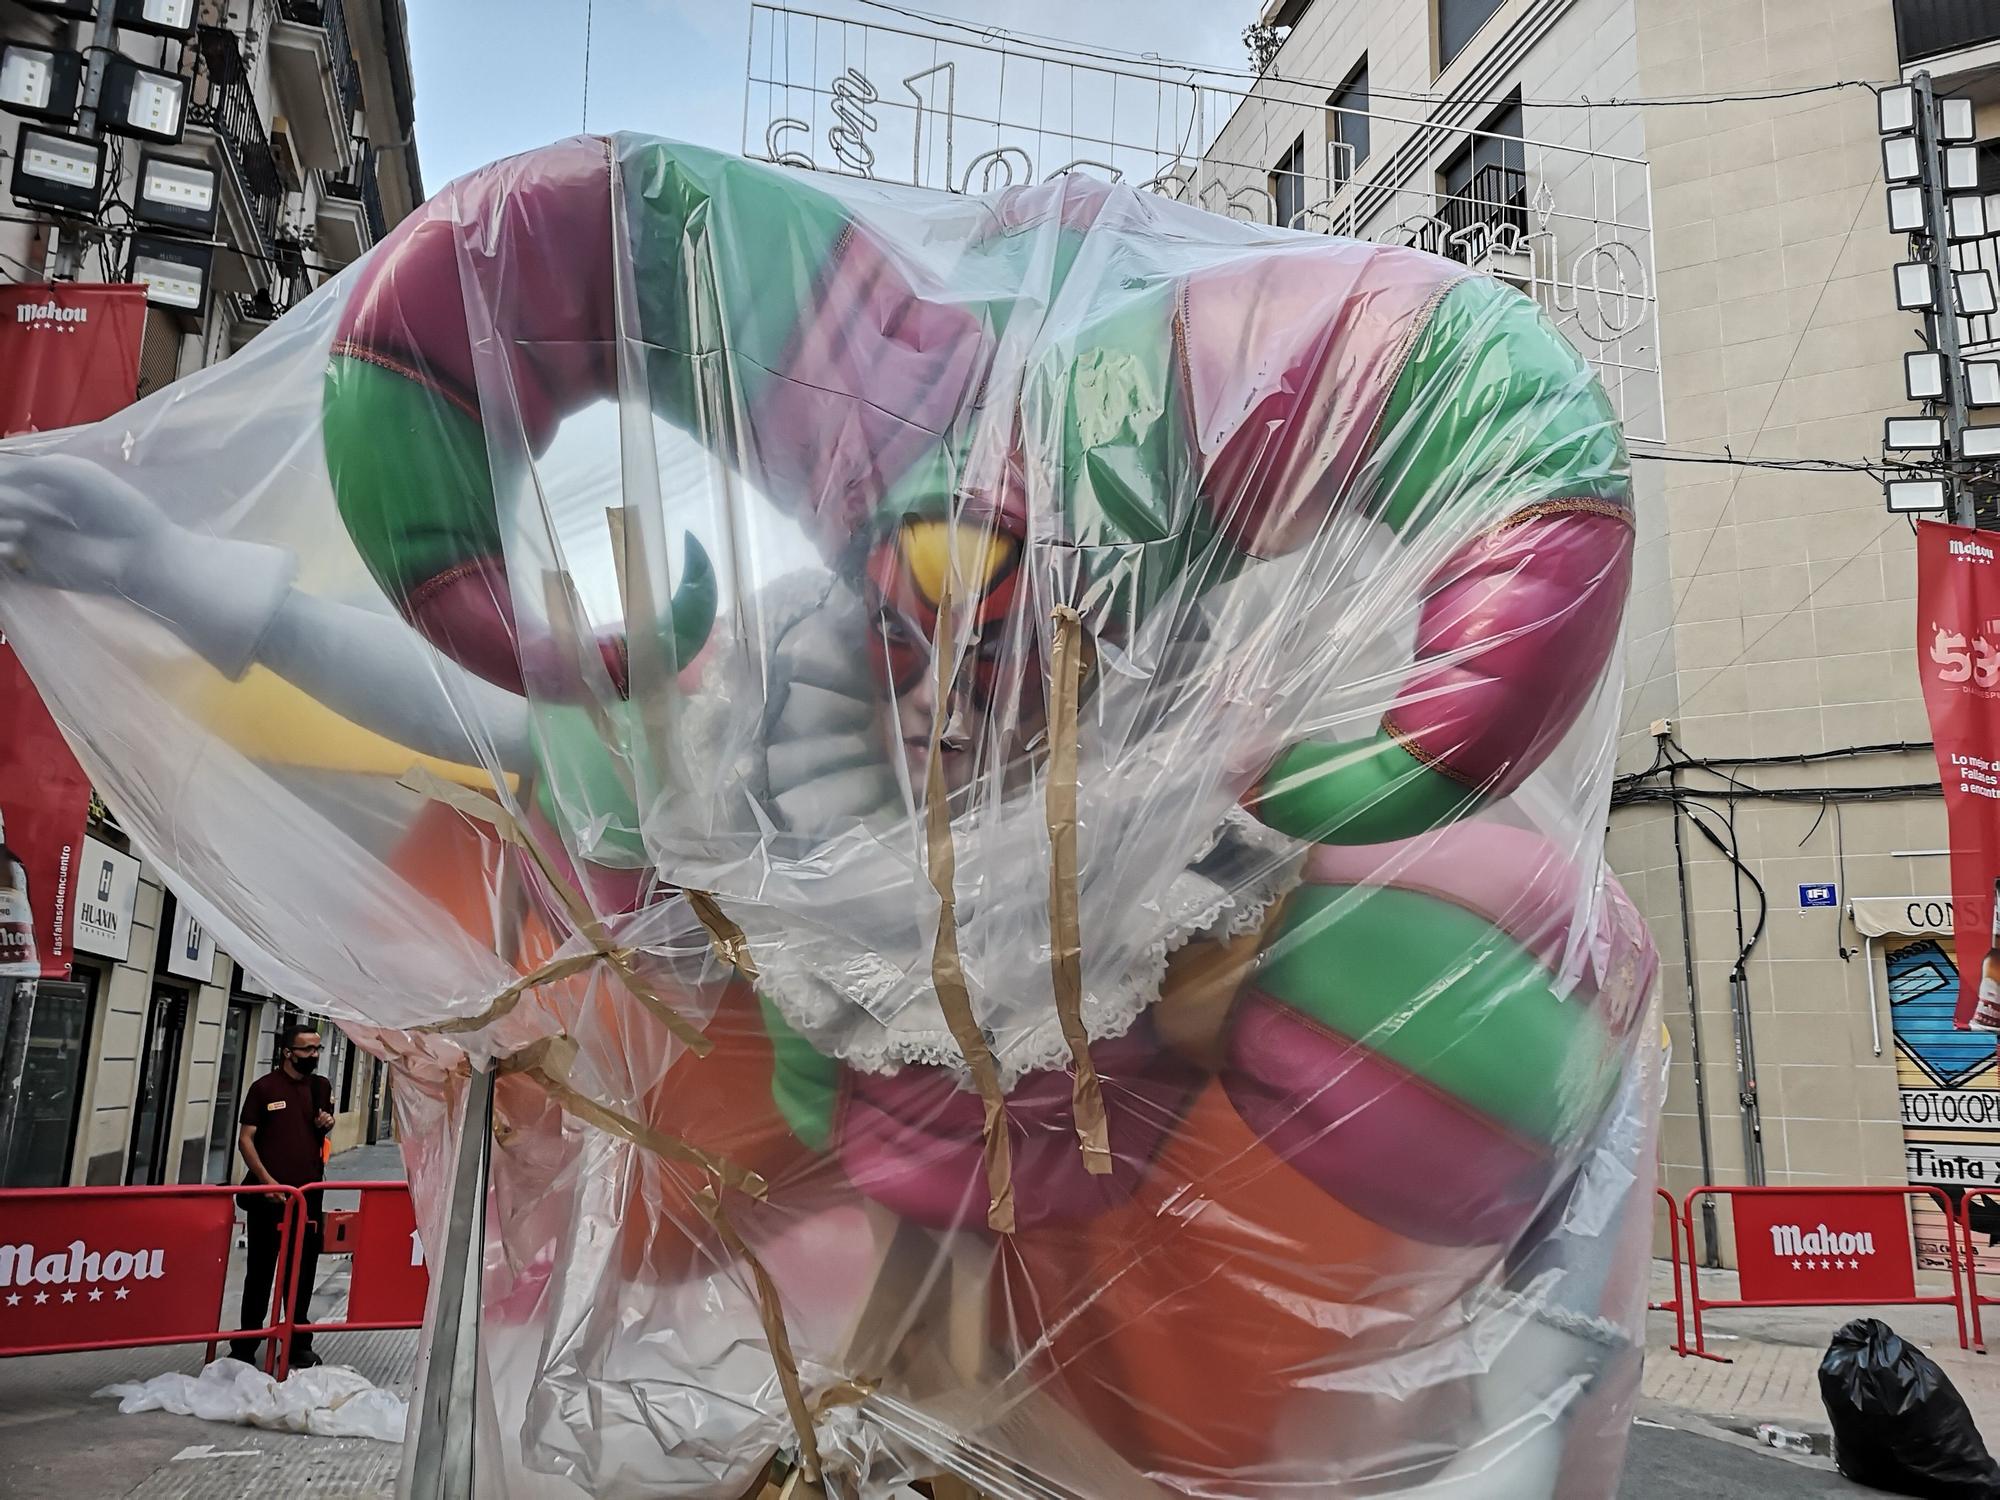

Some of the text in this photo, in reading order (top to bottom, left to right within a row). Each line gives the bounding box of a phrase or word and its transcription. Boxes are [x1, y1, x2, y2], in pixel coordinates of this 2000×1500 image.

[17, 300, 87, 322] Mahou
[1949, 539, 1994, 559] Mahou
[1951, 753, 1968, 765] Lo
[1960, 783, 1969, 792] a
[53, 845, 71, 956] #lasfallasdelencuentro
[81, 902, 118, 931] HUAXIN
[1908, 1147, 1984, 1179] Tinta
[1770, 1224, 1876, 1256] Mahou
[0, 1240, 165, 1287] Mahou
